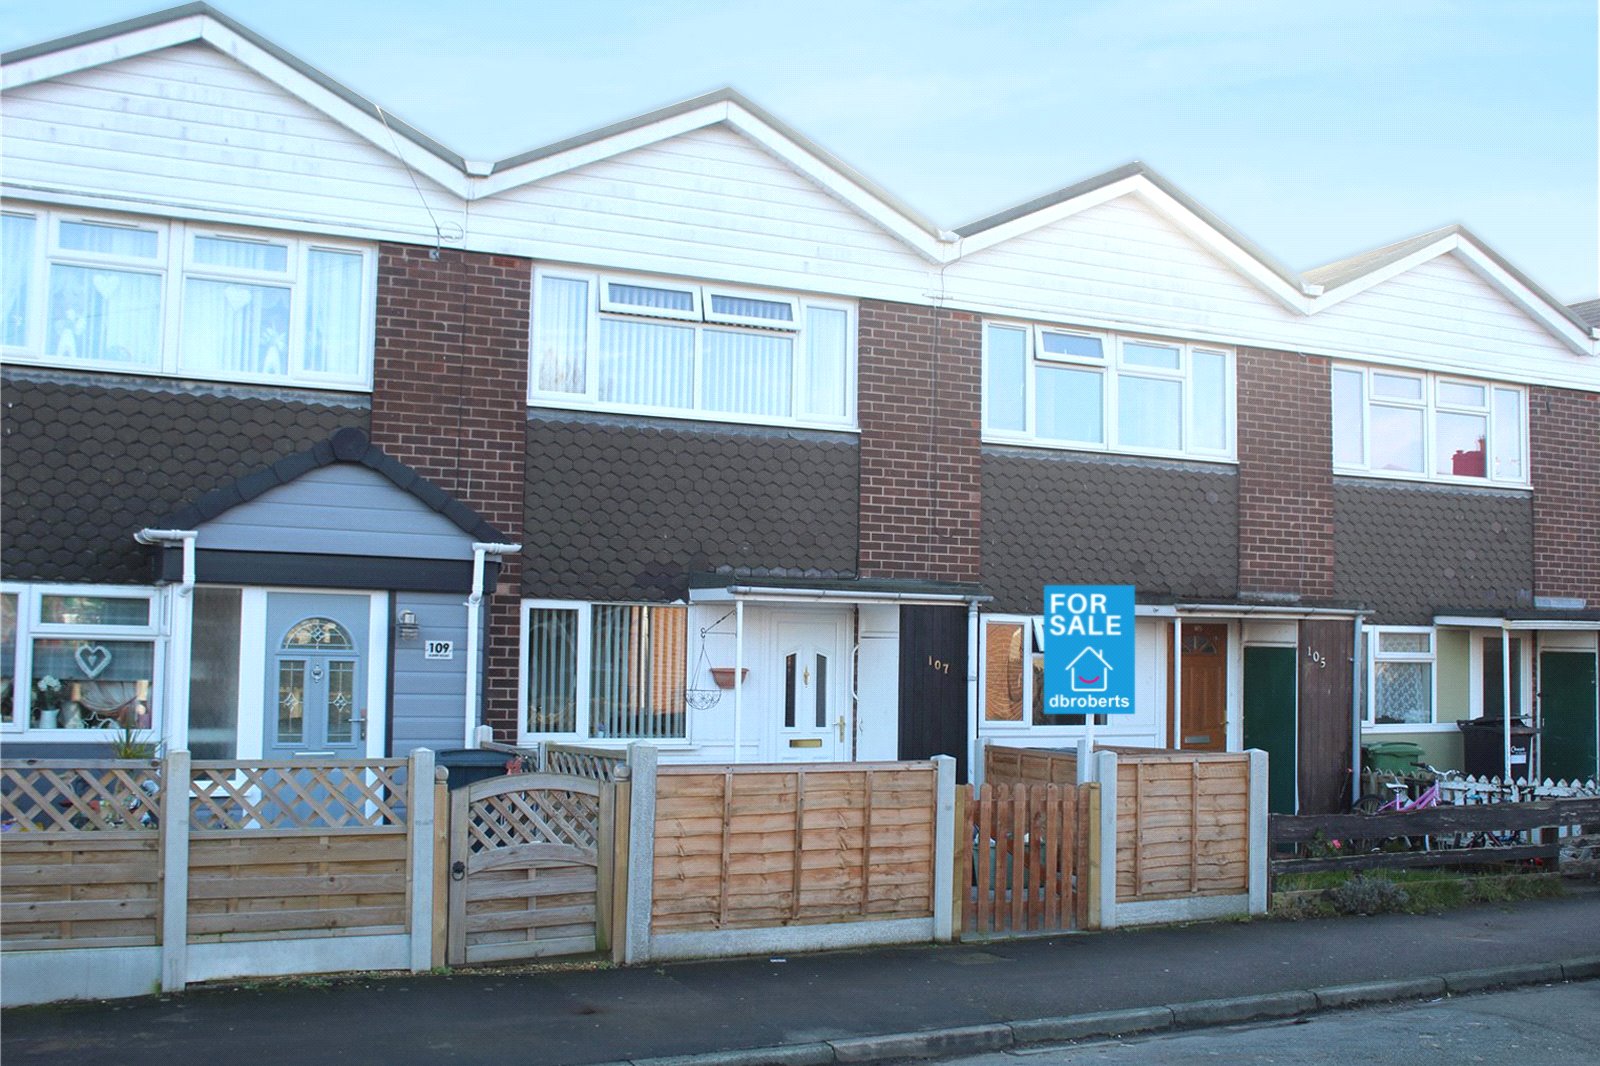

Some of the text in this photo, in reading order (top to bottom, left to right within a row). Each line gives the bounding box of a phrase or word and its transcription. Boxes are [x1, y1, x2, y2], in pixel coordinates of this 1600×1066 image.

[1050, 593, 1107, 614] FOR
[1050, 615, 1121, 636] SALE
[429, 642, 450, 653] 109
[1308, 646, 1326, 668] 105
[928, 655, 949, 674] 107
[1049, 694, 1130, 708] dbroberts
